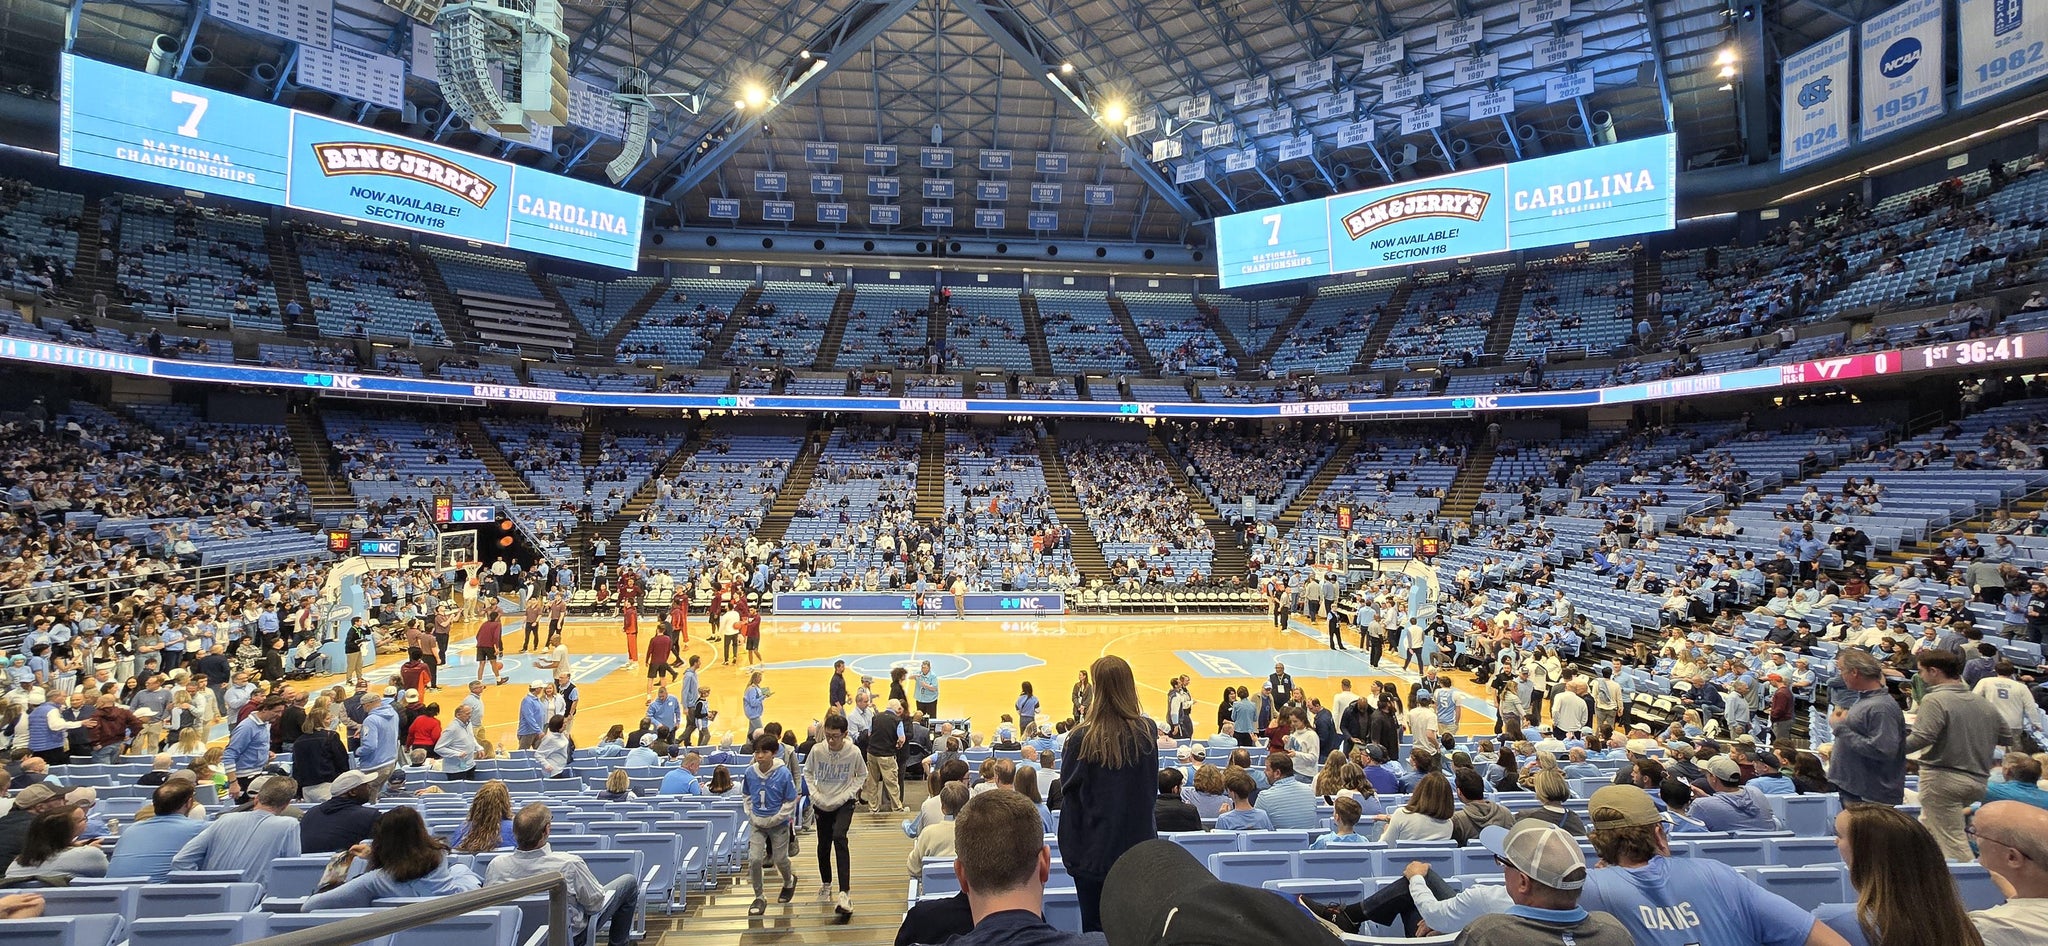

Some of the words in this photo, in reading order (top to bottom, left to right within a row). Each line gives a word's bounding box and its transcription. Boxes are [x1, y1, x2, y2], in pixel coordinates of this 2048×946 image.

[1536, 11, 1554, 22] 1977
[1451, 35, 1468, 45] 1972
[1550, 37, 1566, 47] NCAA
[1541, 46, 1557, 55] FINAL
[1558, 42, 1574, 51] FOUR
[1374, 55, 1391, 64] 1969
[1469, 58, 1483, 66] NCAA
[1548, 51, 1567, 62] 1998
[1884, 50, 1920, 73] NCAA
[1975, 41, 2043, 83] 1982
[1461, 64, 1476, 73] FINAL
[1477, 61, 1491, 70] FOUR
[1396, 75, 1410, 84] NCAA
[1467, 71, 1484, 80] 1997
[1389, 83, 1403, 92] FINAL
[1403, 79, 1417, 88] FOUR
[1395, 89, 1412, 99] 1995
[1559, 87, 1580, 98] 2022
[1477, 99, 1492, 107] FINAL
[1492, 95, 1506, 104] FOUR
[1873, 86, 1929, 121] 1957
[171, 90, 208, 138] 7
[1414, 107, 1427, 116] NCAA
[1483, 105, 1500, 115] 2017
[1408, 115, 1421, 123] FINAL
[1421, 112, 1434, 120] FOUR
[1412, 121, 1430, 130] 2016
[1347, 133, 1363, 143] 2009
[1793, 123, 1837, 152] 1924
[142, 138, 234, 166] NATIONAL
[116, 147, 256, 184] CHAMPIONSHIPS
[1514, 169, 1655, 211] CAROLINA
[350, 186, 385, 203] NOW
[385, 193, 461, 217] AVAILABLE!
[1551, 200, 1612, 216] BASKETBALL
[364, 205, 426, 226] SECTION
[426, 216, 446, 229] 118
[517, 193, 628, 236] CAROLINA
[1262, 214, 1282, 246] 7
[1370, 238, 1396, 250] NOW
[1398, 229, 1459, 245] AVAILABLE!
[1253, 249, 1298, 263] NATIONAL
[1383, 247, 1430, 261] SECTION
[1431, 245, 1446, 254] 118
[1241, 257, 1312, 274] CHAMPIONSHIPS
[29, 343, 135, 370] BASKETBALL
[1922, 346, 1949, 368] 1ST
[1956, 336, 2024, 365] 36:41
[1875, 354, 1887, 374] 0
[332, 375, 361, 389] NC
[473, 386, 506, 399] GAME
[508, 387, 557, 401] SPONSOR
[737, 396, 755, 408] NC
[900, 400, 926, 411] GAME
[928, 400, 968, 412] SPONSOR
[1475, 396, 1498, 408] NC
[1138, 404, 1156, 414] NC
[1280, 404, 1306, 416] GAME
[1307, 402, 1350, 414] SPONSOR
[464, 509, 488, 521] NC
[380, 543, 397, 553] NC
[1395, 548, 1410, 556] NC
[822, 598, 842, 609] NC
[1020, 598, 1039, 609] NC
[1441, 695, 1448, 708] 5
[758, 790, 767, 810] 1
